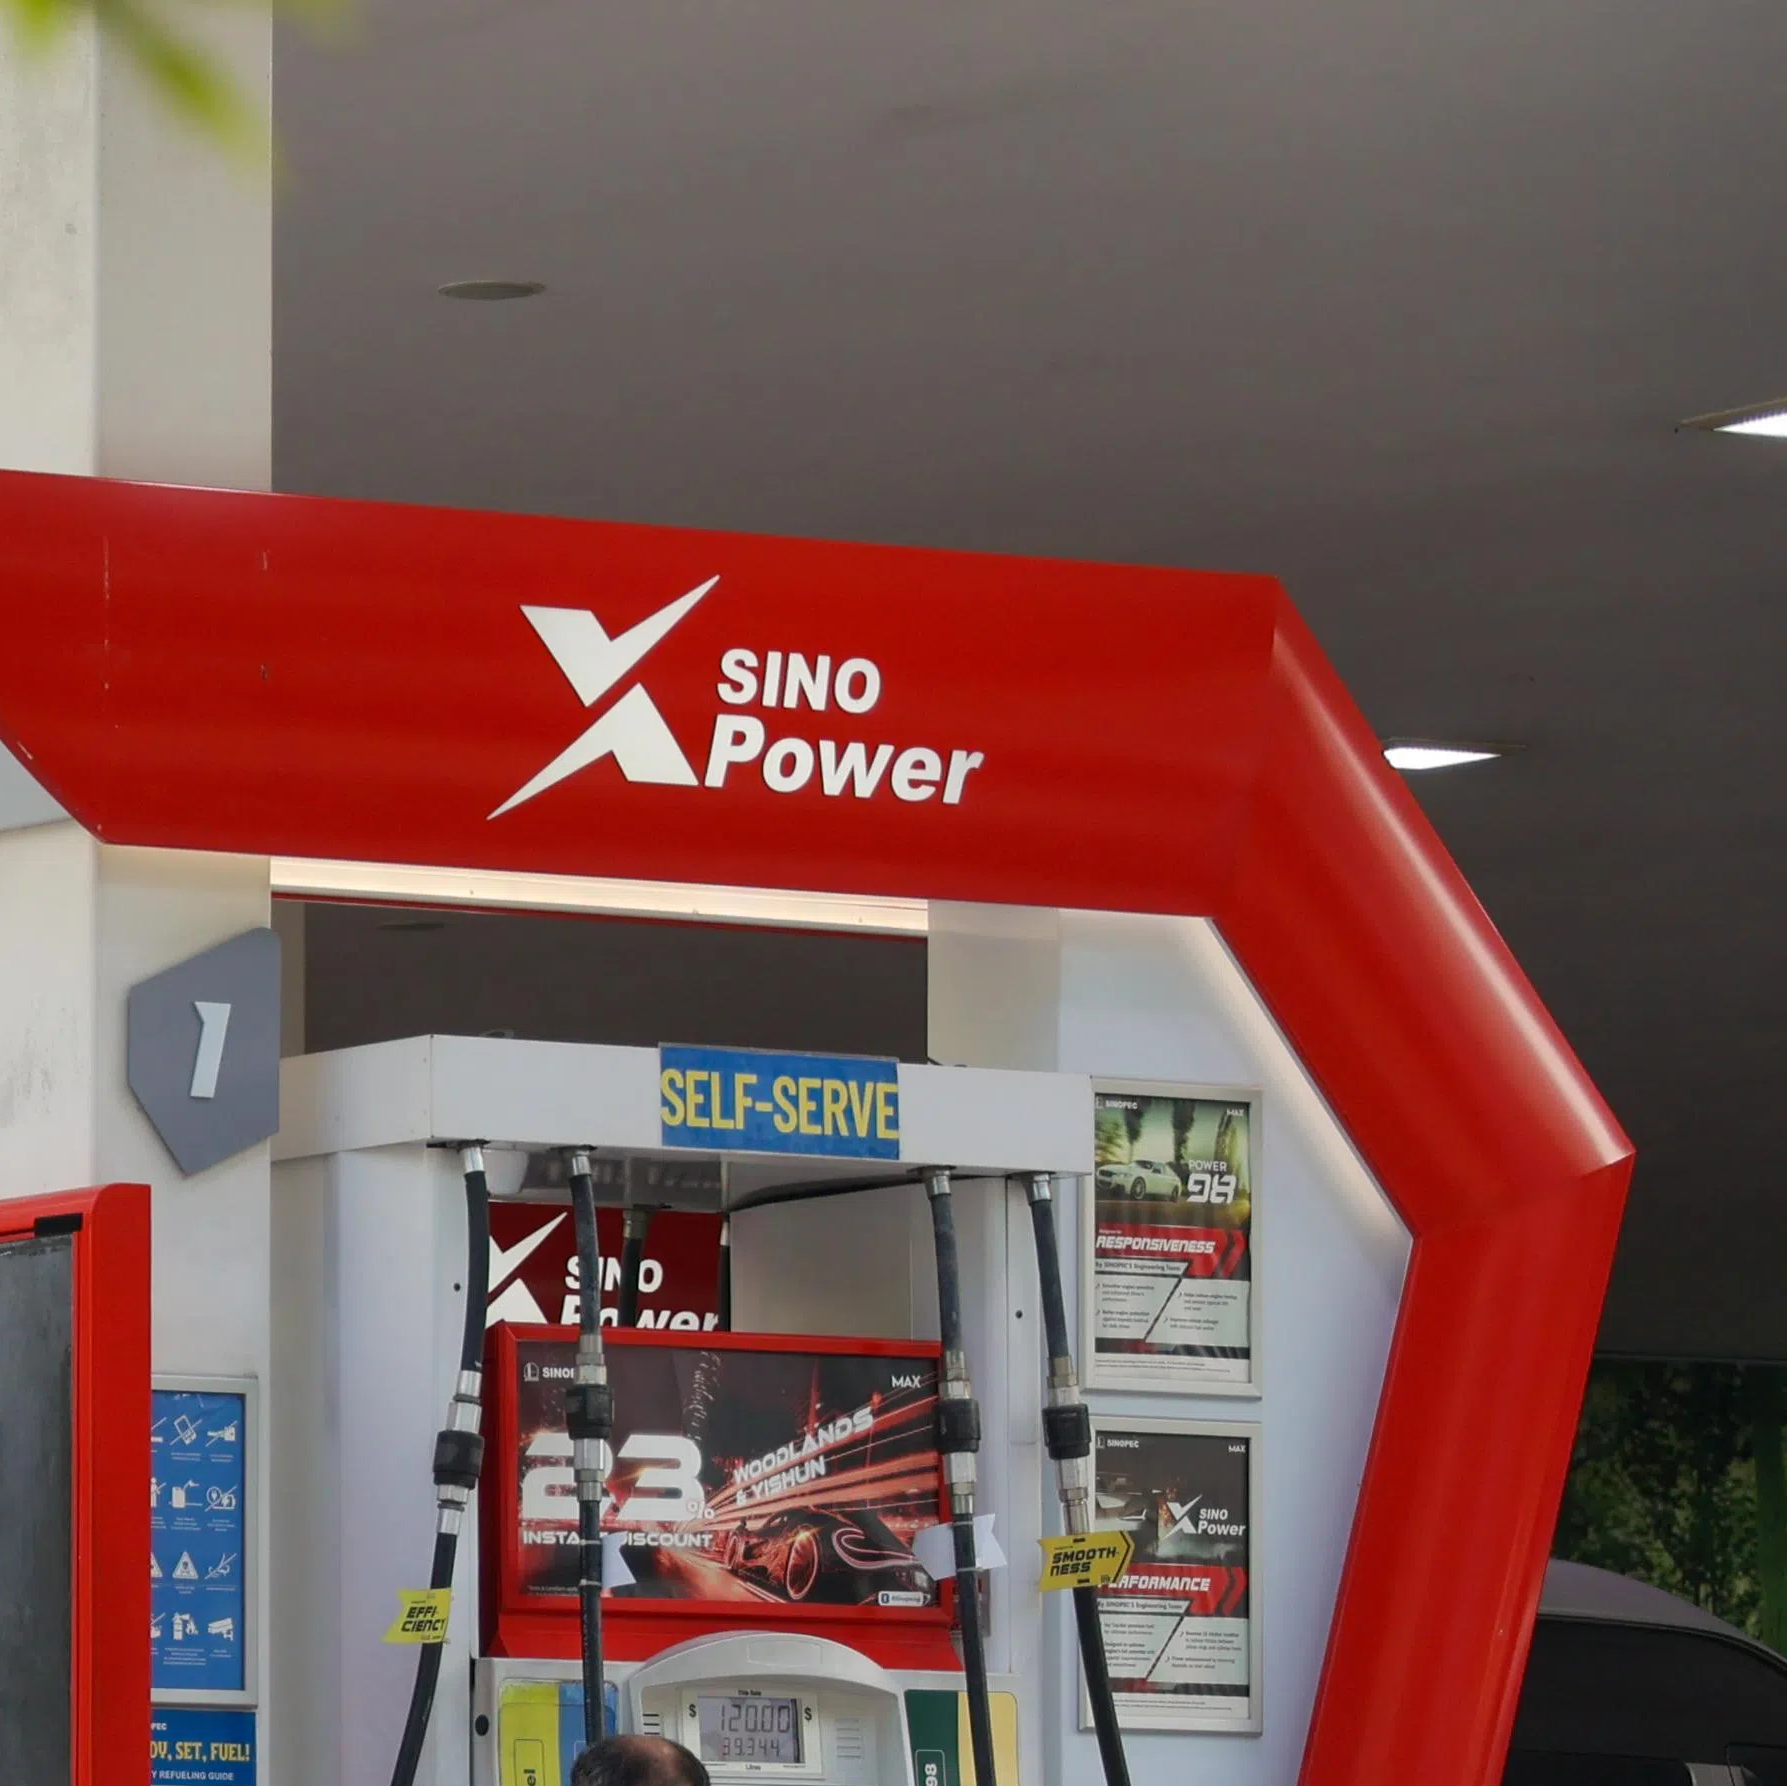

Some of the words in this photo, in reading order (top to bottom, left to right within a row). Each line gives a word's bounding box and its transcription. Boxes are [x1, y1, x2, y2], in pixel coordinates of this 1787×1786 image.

[717, 648, 881, 713] SINO
[704, 713, 984, 805] Power
[190, 1001, 231, 1099] 1
[660, 1068, 899, 1139] SELF-SERVE
[1189, 1159, 1227, 1171] POWER
[1187, 1173, 1236, 1204] 98
[1096, 1235, 1215, 1254] RESPONSIVENESS
[891, 1375, 921, 1388] MAX
[734, 1406, 874, 1484] WOODLANDS
[1107, 1439, 1139, 1448] SINOPEC
[750, 1457, 826, 1499] YISHUN
[1199, 1508, 1228, 1521] SINO
[1197, 1520, 1246, 1537] Power
[688, 1704, 697, 1718] $
[804, 1706, 813, 1721] $
[210, 1743, 250, 1762] FUEL!
[159, 1770, 206, 1780] REFUELING
[208, 1772, 234, 1781] GUIDE
